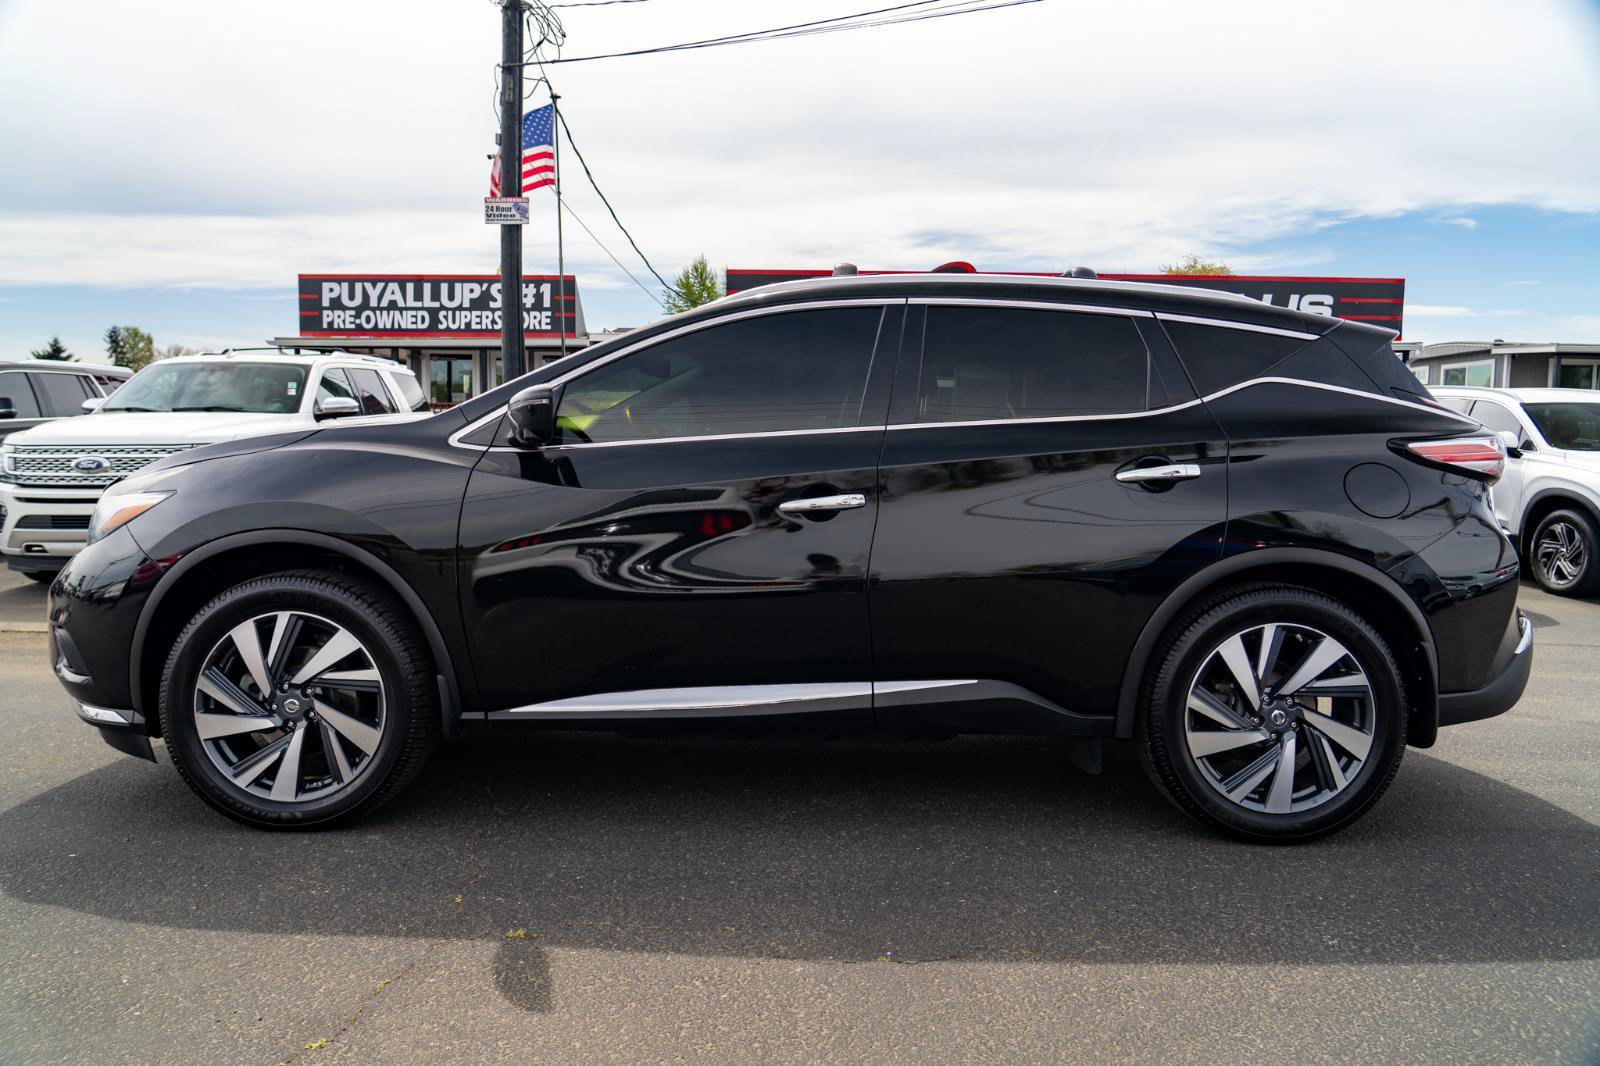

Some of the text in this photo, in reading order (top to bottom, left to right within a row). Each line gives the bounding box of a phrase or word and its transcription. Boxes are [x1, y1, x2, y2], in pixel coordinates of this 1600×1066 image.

[485, 205, 513, 213] 24 Hour
[321, 281, 551, 309] PUYALLUP'S #1
[322, 310, 552, 330] PRE-OWNED SUPERSRE
